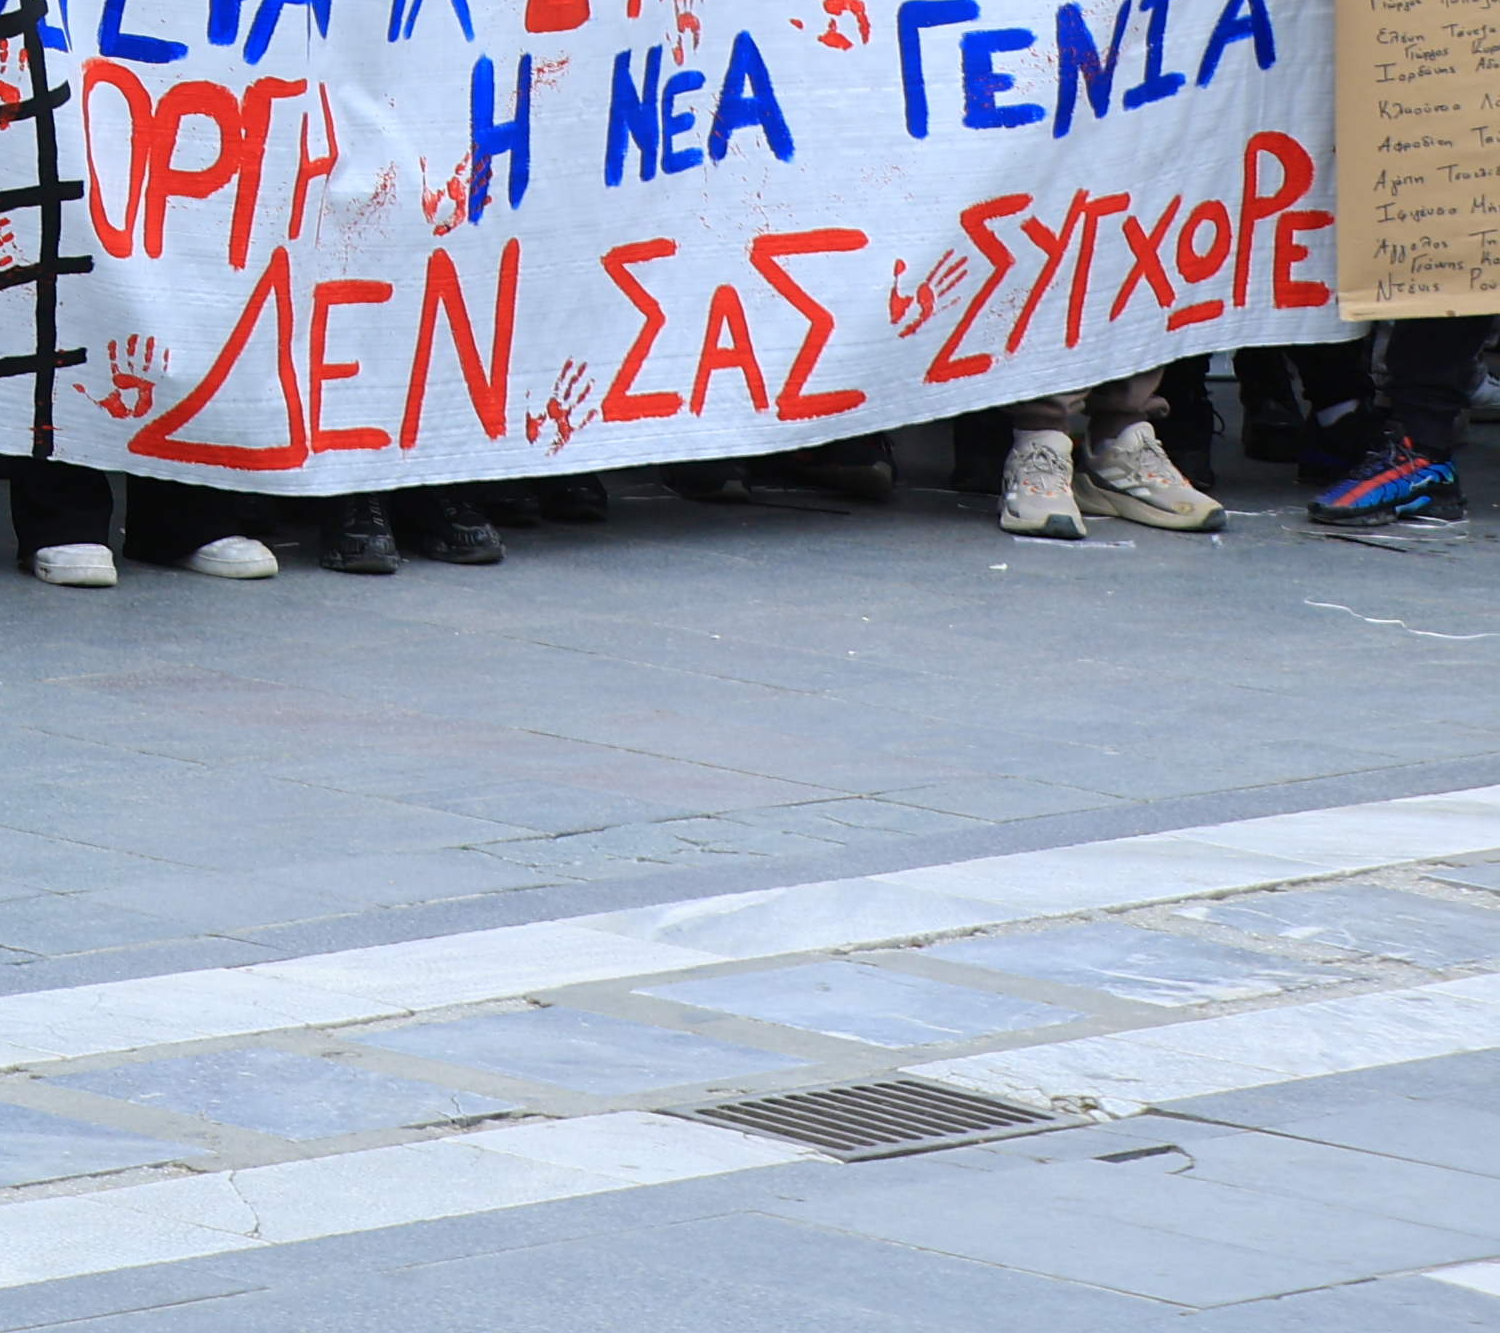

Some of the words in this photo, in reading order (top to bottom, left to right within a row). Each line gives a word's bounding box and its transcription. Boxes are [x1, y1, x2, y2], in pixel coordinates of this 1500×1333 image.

[468, 54, 532, 224] Η
[605, 31, 795, 187] ΝΕΑ
[128, 238, 519, 471] ΔΕΝ
[602, 228, 867, 421] ΣΑΣ
[924, 131, 1336, 385] ΣΥΓΧΩΡΕ
